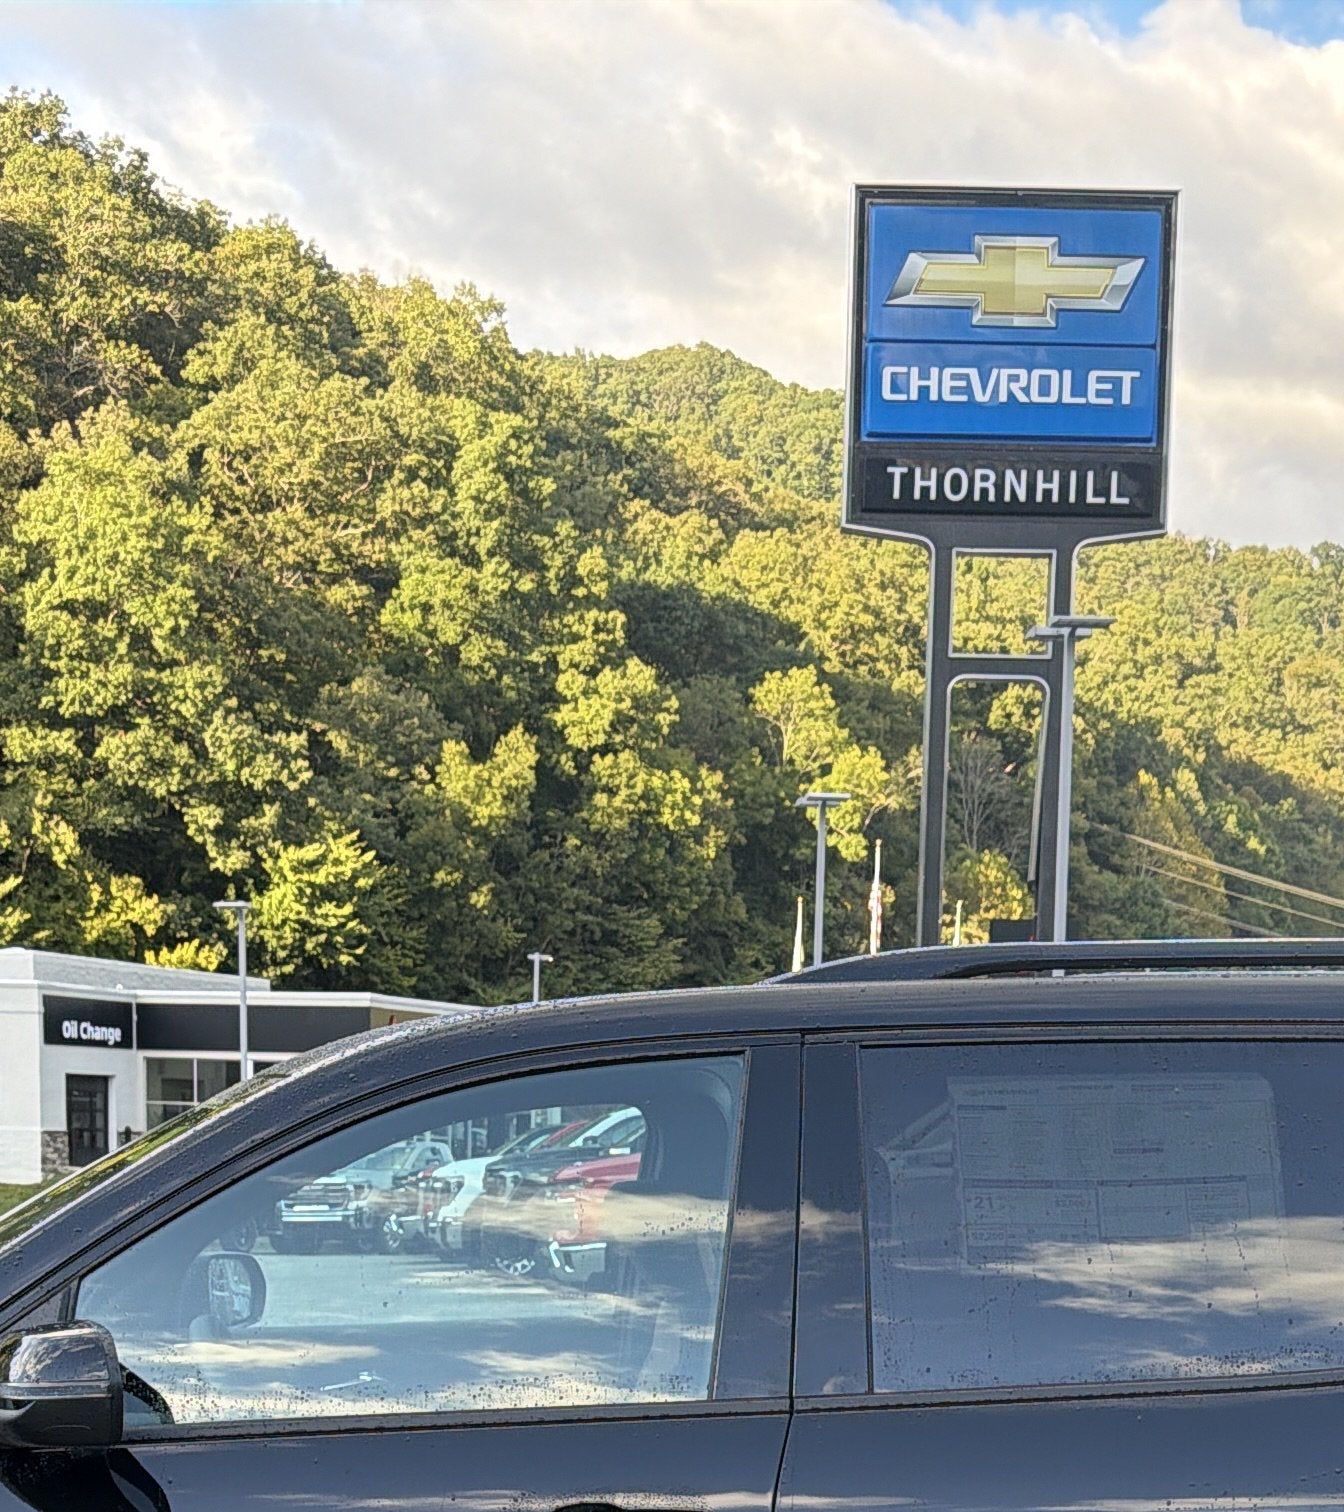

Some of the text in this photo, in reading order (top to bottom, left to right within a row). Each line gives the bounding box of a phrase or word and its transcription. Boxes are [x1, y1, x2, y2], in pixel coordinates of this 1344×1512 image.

[881, 365, 1141, 406] CHEVROLET
[886, 465, 1131, 505] THORNHILL
[61, 1020, 122, 1046] Oil Change
